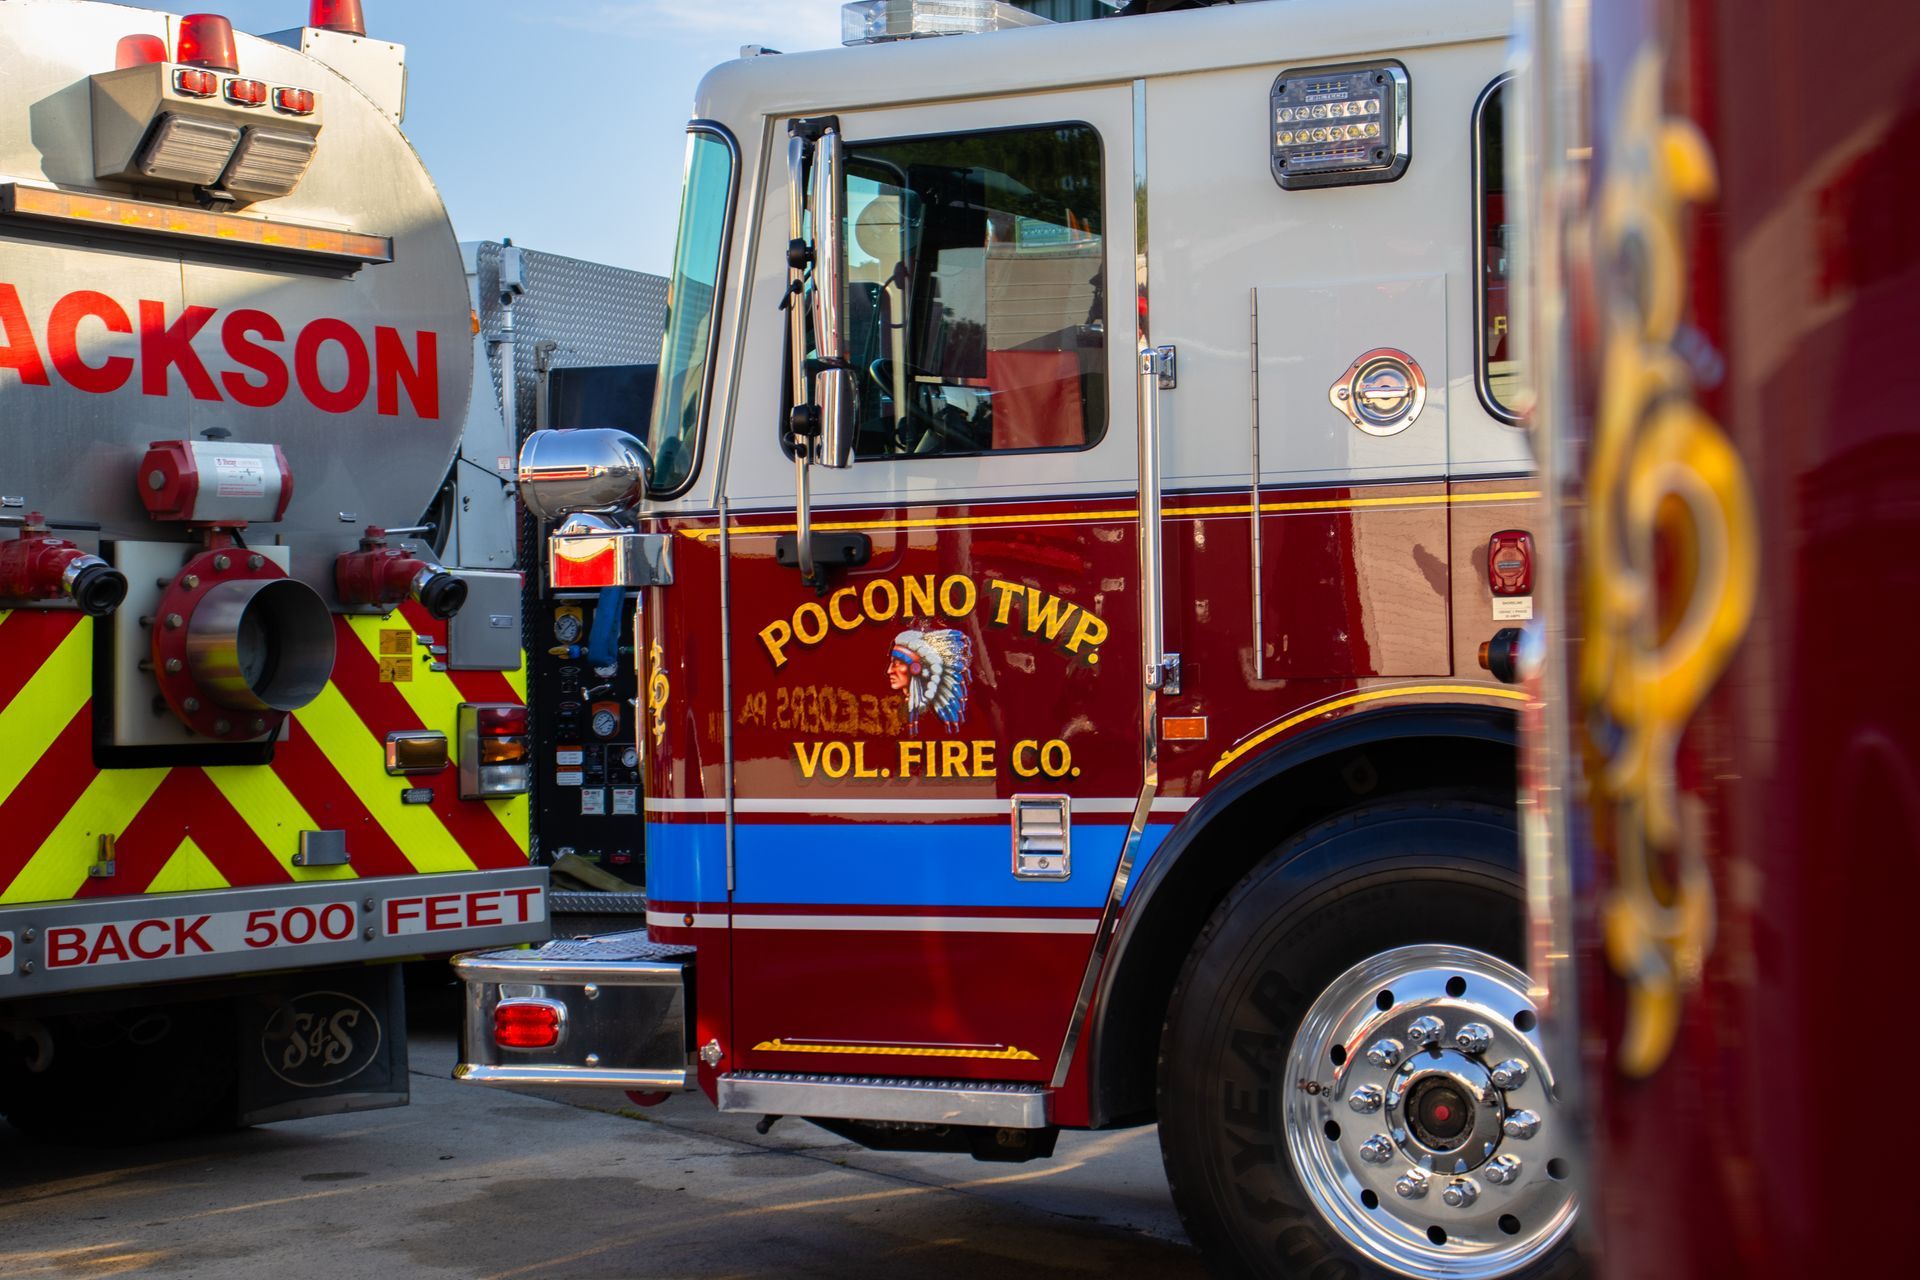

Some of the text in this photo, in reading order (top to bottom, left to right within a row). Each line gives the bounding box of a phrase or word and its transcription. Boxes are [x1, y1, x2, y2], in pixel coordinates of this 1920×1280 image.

[758, 574, 1108, 667] POCONO TWP.
[793, 739, 1081, 778] VOL. FIRE CO.
[46, 914, 214, 968] BACK
[244, 902, 355, 948] 500
[387, 887, 541, 935] FEET
[281, 1008, 361, 1071] S&S
